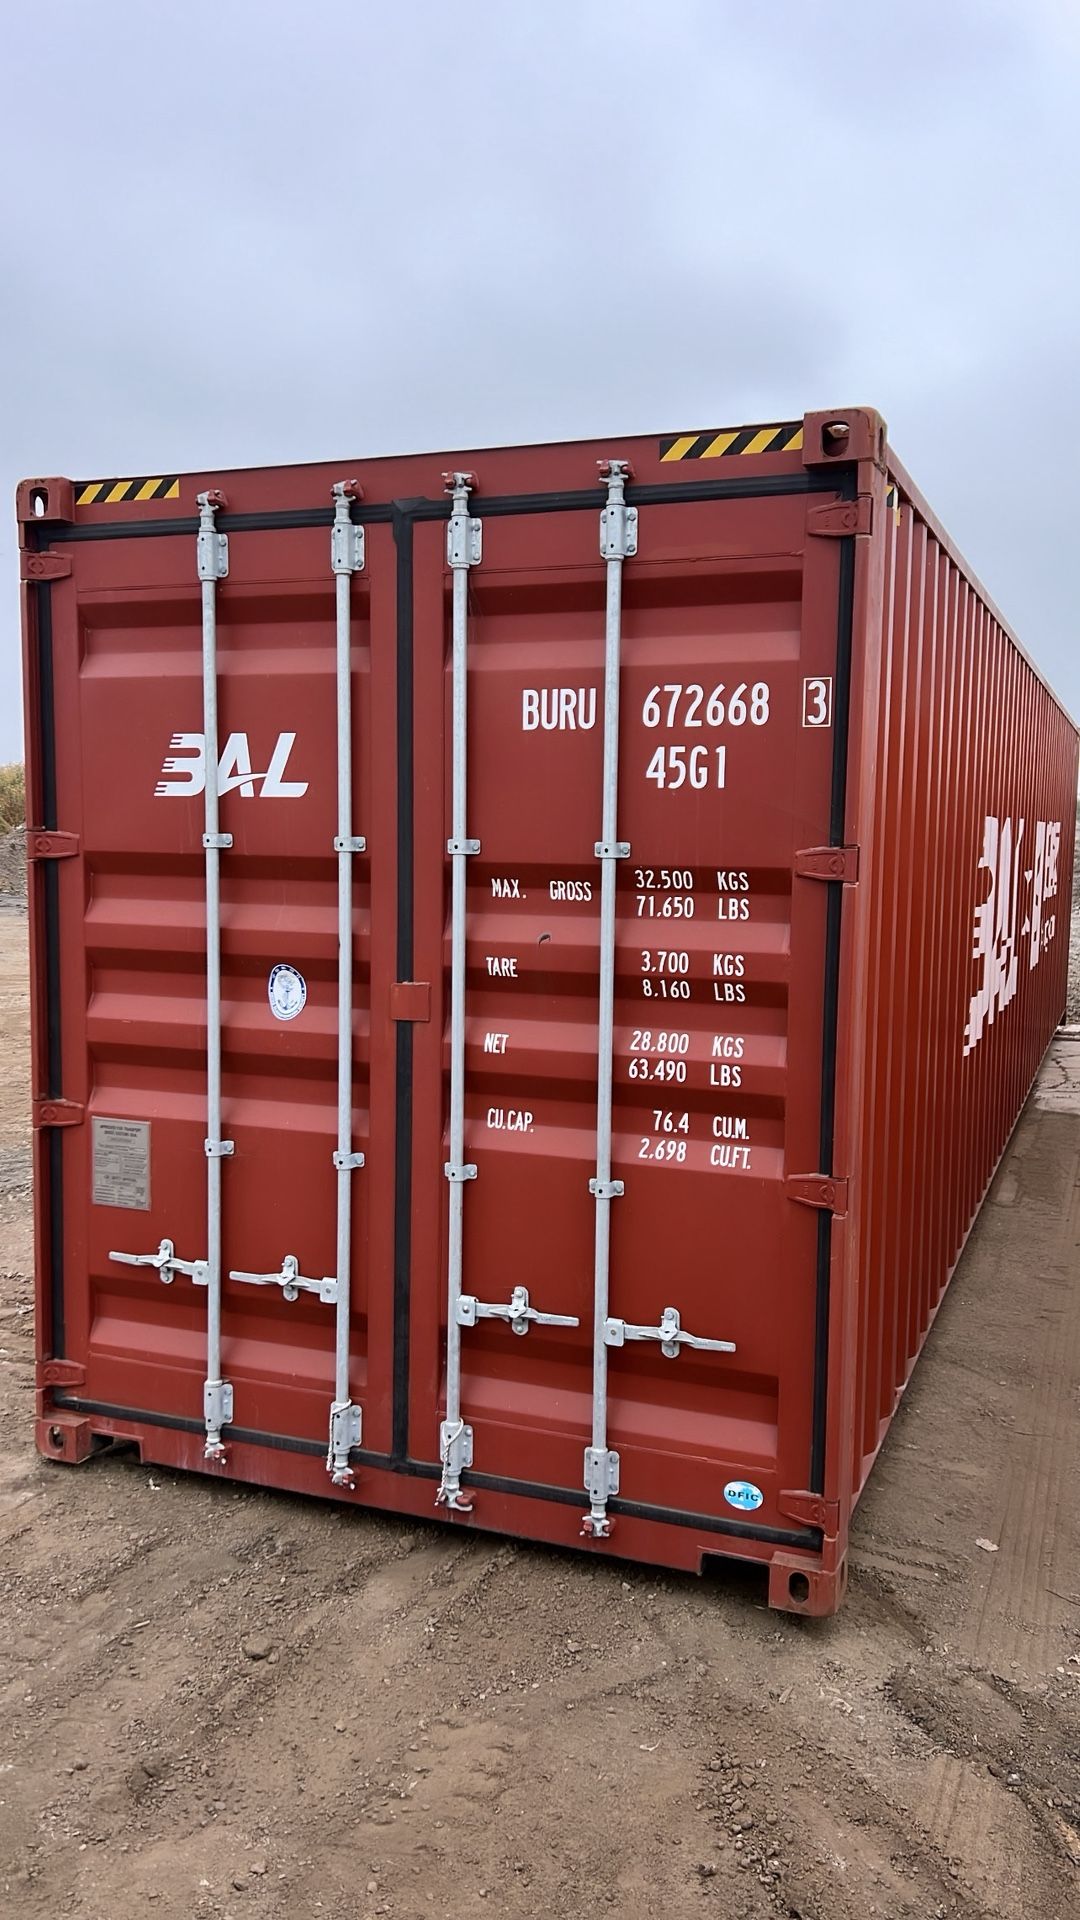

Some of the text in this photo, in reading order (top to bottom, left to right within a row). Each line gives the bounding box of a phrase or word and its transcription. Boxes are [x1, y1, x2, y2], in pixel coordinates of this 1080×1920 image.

[523, 681, 827, 730] BURU 672668 3
[154, 733, 309, 797] BAL
[646, 746, 726, 788] 45G1
[492, 878, 527, 899] MAX.
[550, 880, 592, 902] GROSS
[717, 872, 749, 891] KGS
[718, 898, 750, 920] LBS
[486, 957, 518, 978] TARE
[713, 954, 745, 976] KGS
[714, 983, 746, 1002] LBS
[484, 1033, 509, 1054] NET
[712, 1036, 744, 1058] KGS
[710, 1064, 742, 1087] LBS
[653, 1111, 689, 1133] 76.4
[728, 1490, 759, 1502] DFIC
